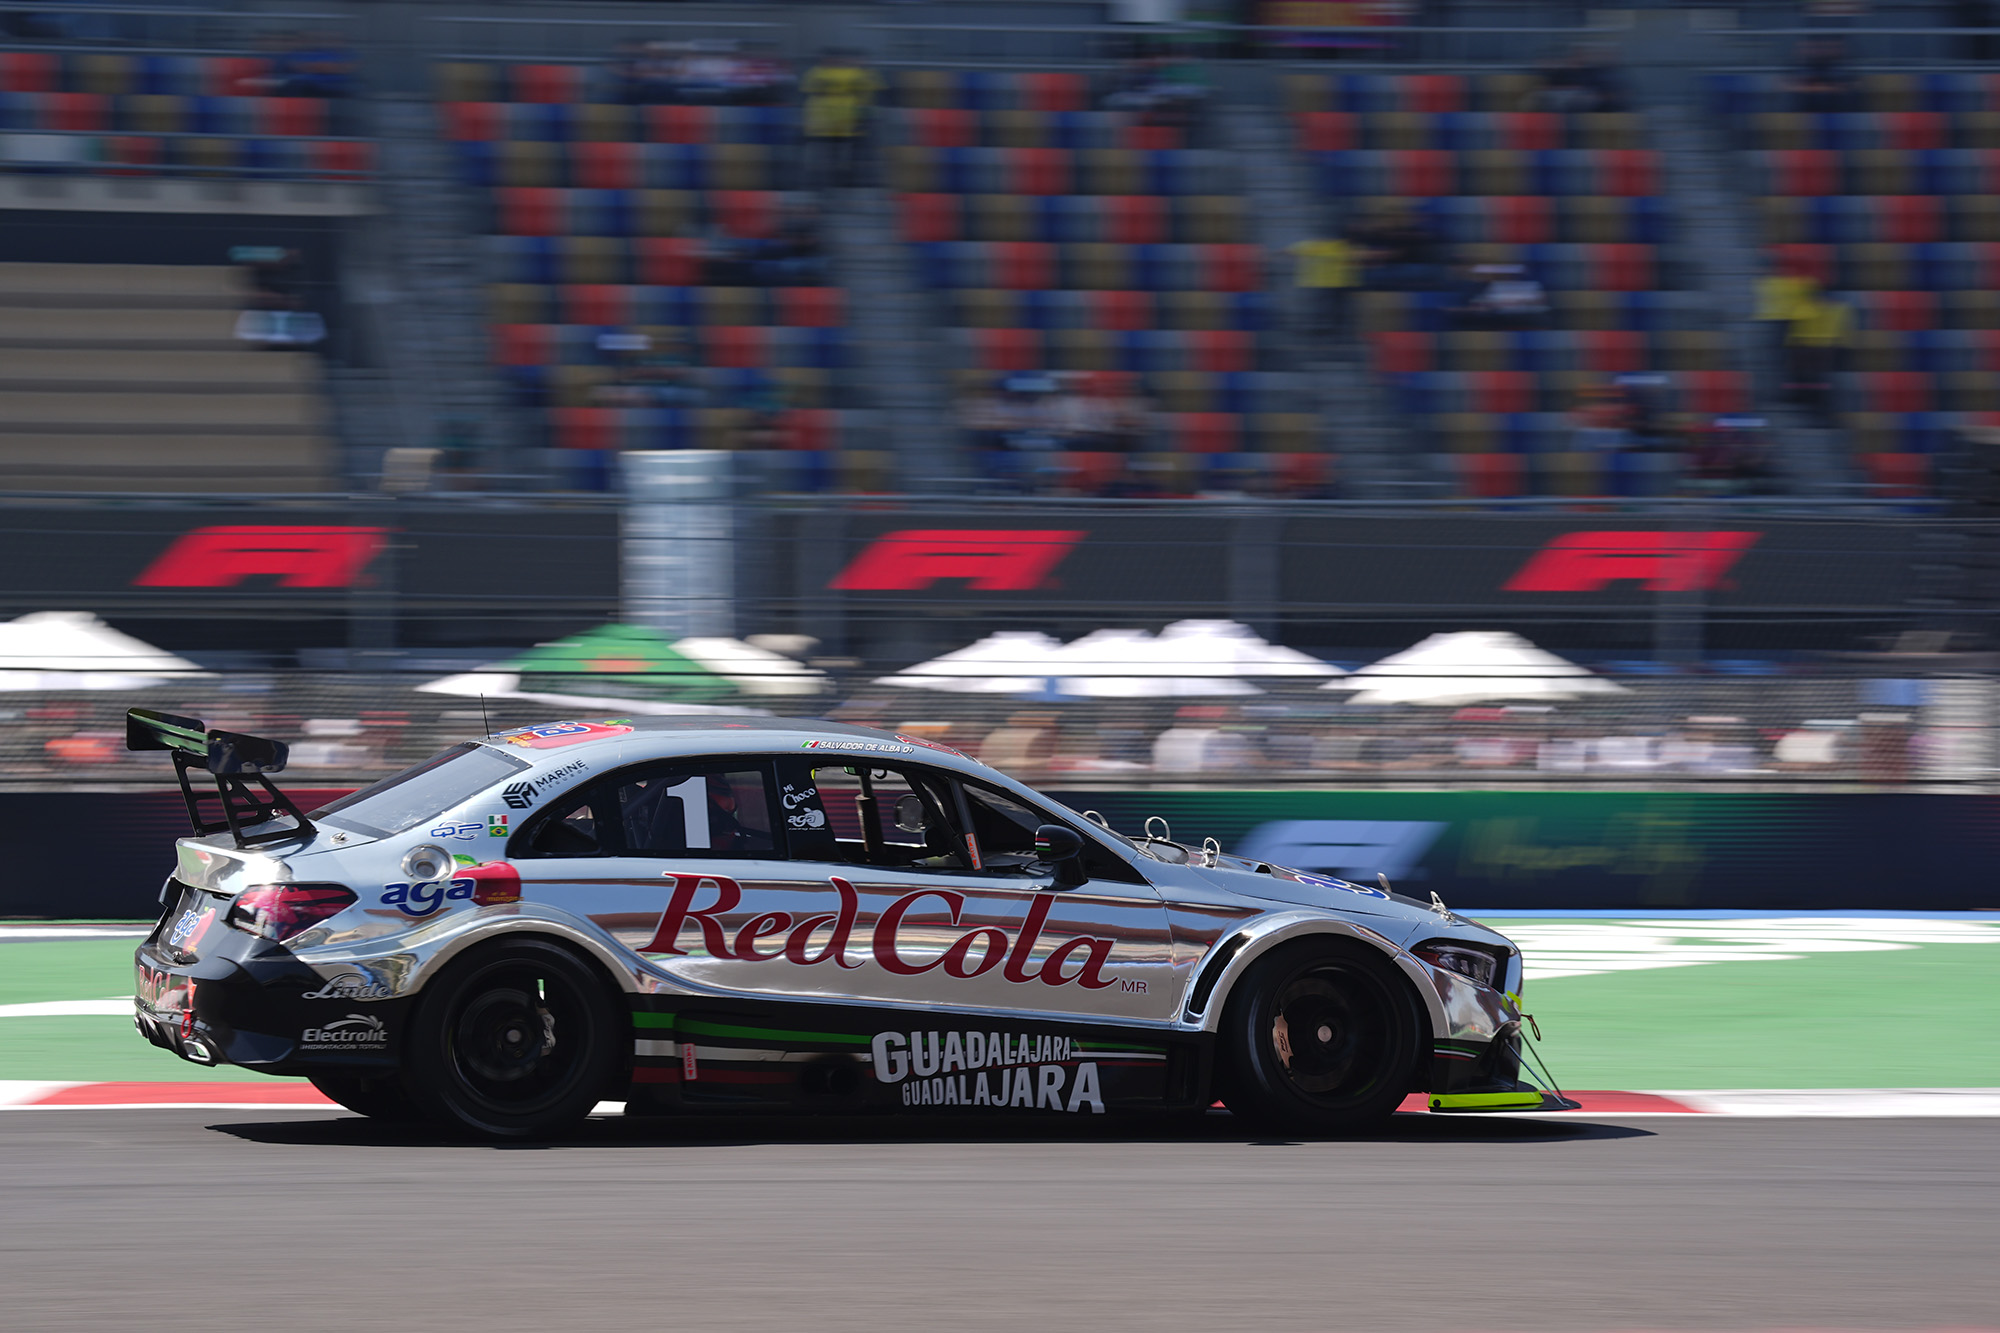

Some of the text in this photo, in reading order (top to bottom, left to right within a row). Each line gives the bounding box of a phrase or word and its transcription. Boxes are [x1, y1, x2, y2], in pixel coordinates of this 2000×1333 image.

[819, 741, 863, 750] SALVADOR
[865, 743, 877, 751] DE
[878, 744, 901, 753] ALBA
[535, 759, 586, 788] MARINE
[666, 776, 711, 849] 1
[380, 877, 476, 917] aga
[170, 909, 201, 945] aga
[301, 973, 390, 999] Linde
[1121, 979, 1148, 994] MR
[302, 1028, 388, 1042] Electrolit
[871, 1031, 1071, 1083] GUADALAJARA
[902, 1062, 1106, 1114] GUADALAJARA
